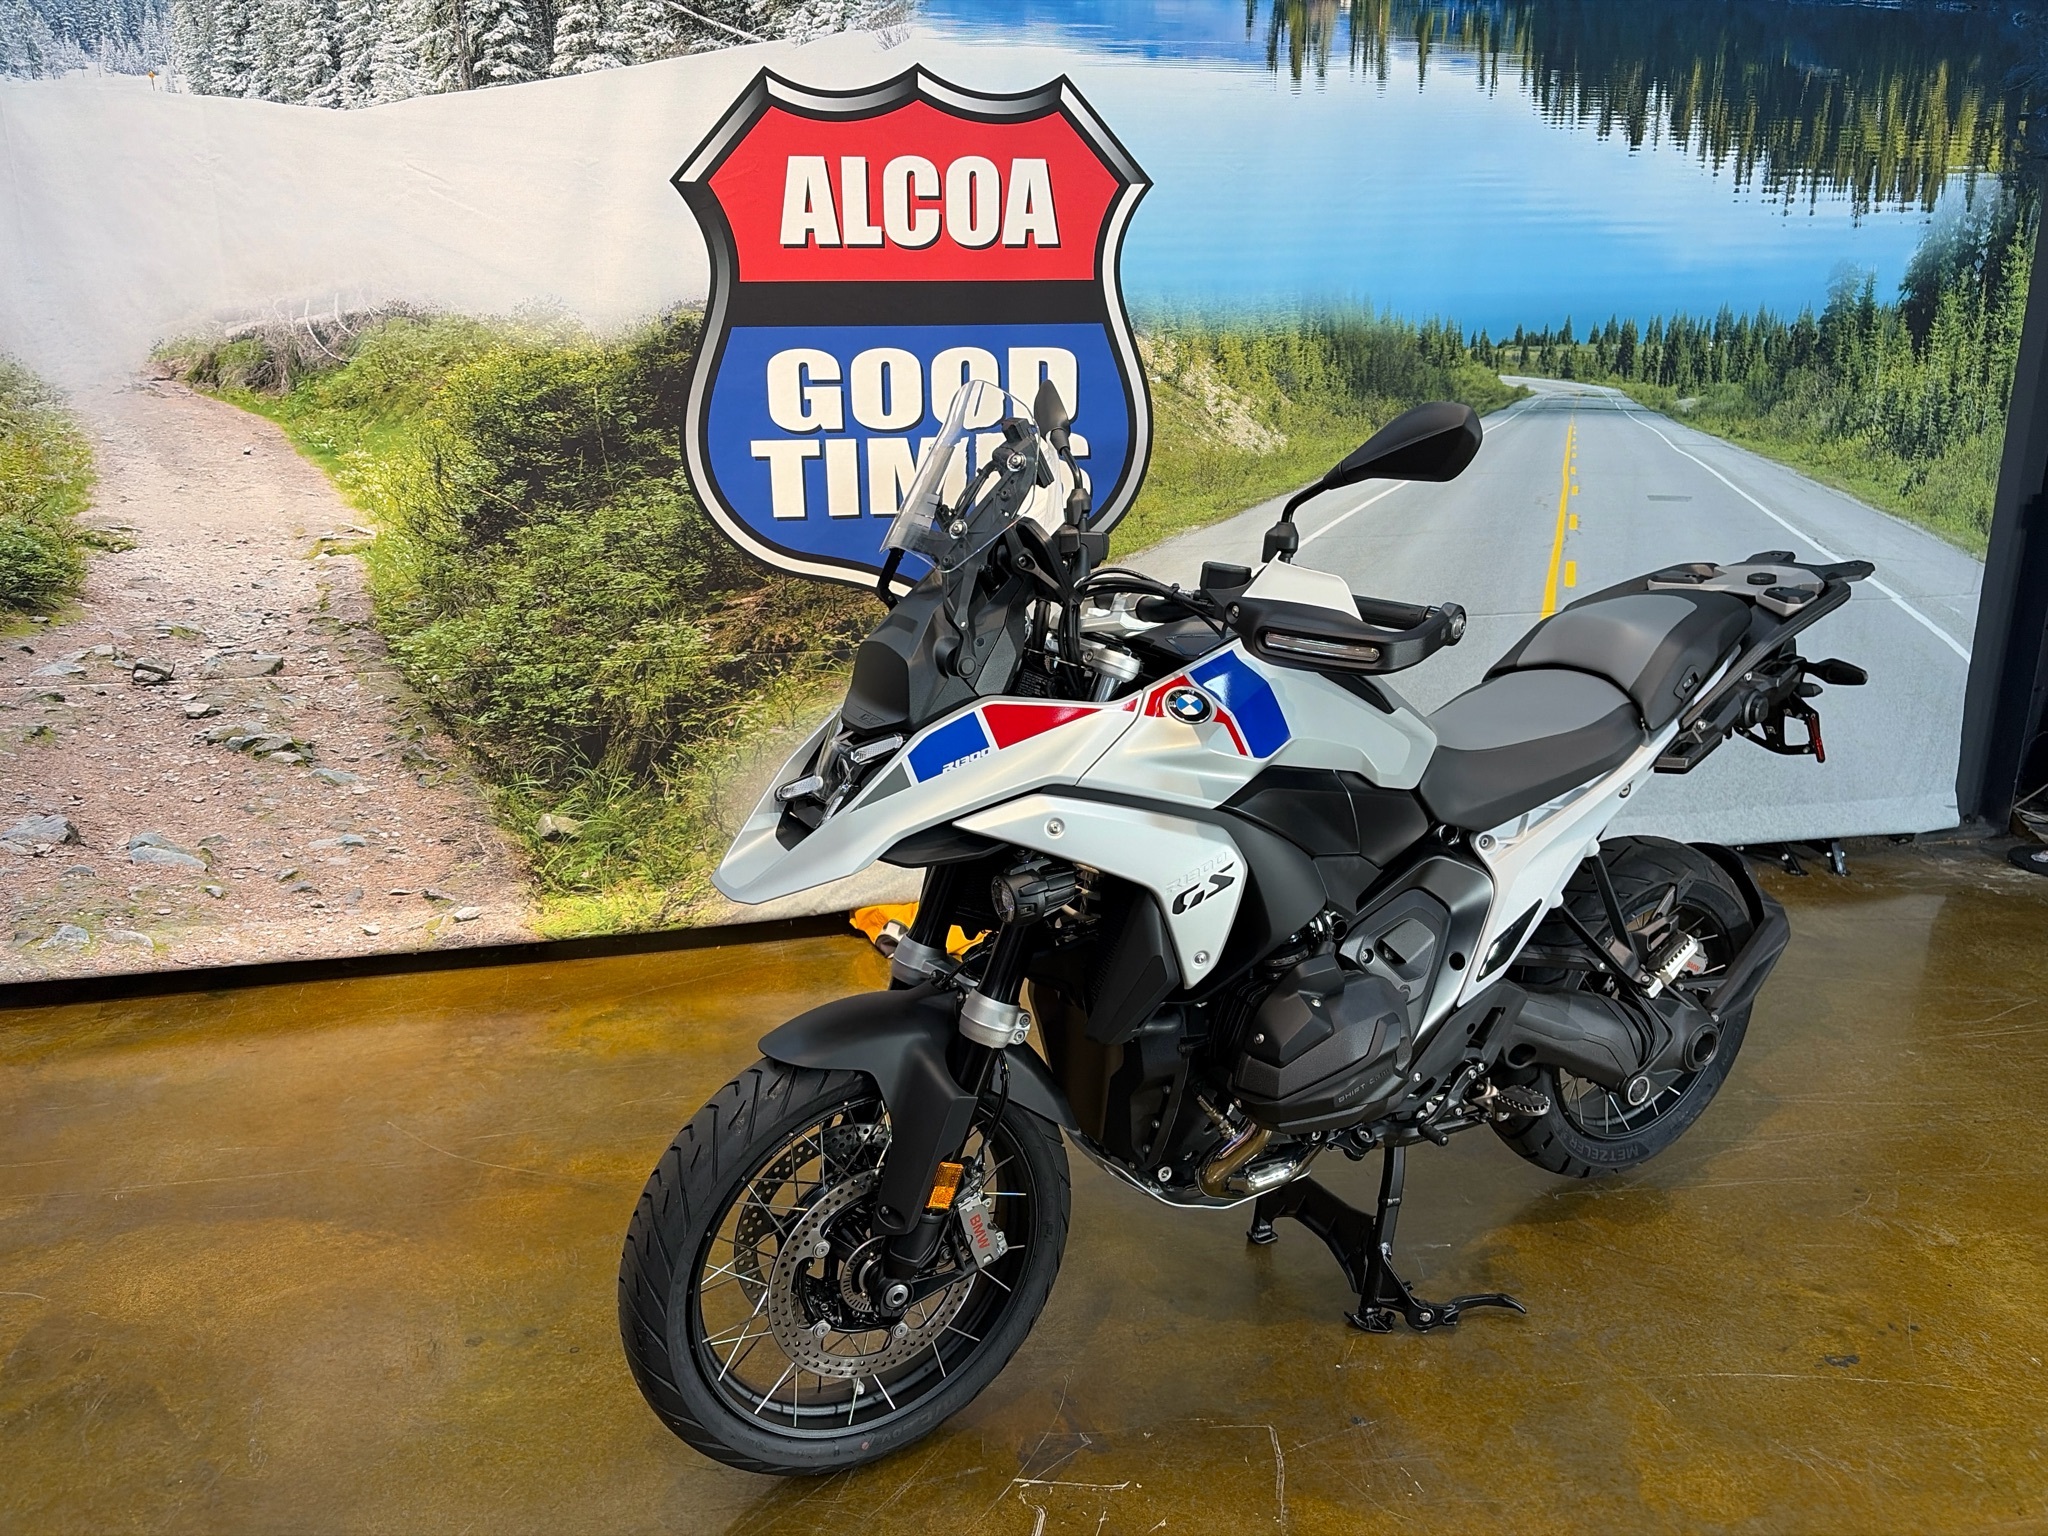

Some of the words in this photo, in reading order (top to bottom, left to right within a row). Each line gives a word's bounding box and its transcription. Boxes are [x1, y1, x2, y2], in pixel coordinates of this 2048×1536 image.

[779, 155, 1061, 249] ALCOA
[766, 346, 1078, 432] GOOD
[1171, 861, 1236, 915] GS
[1569, 1137, 1640, 1162] METZELER
[970, 1213, 990, 1249] BMW
